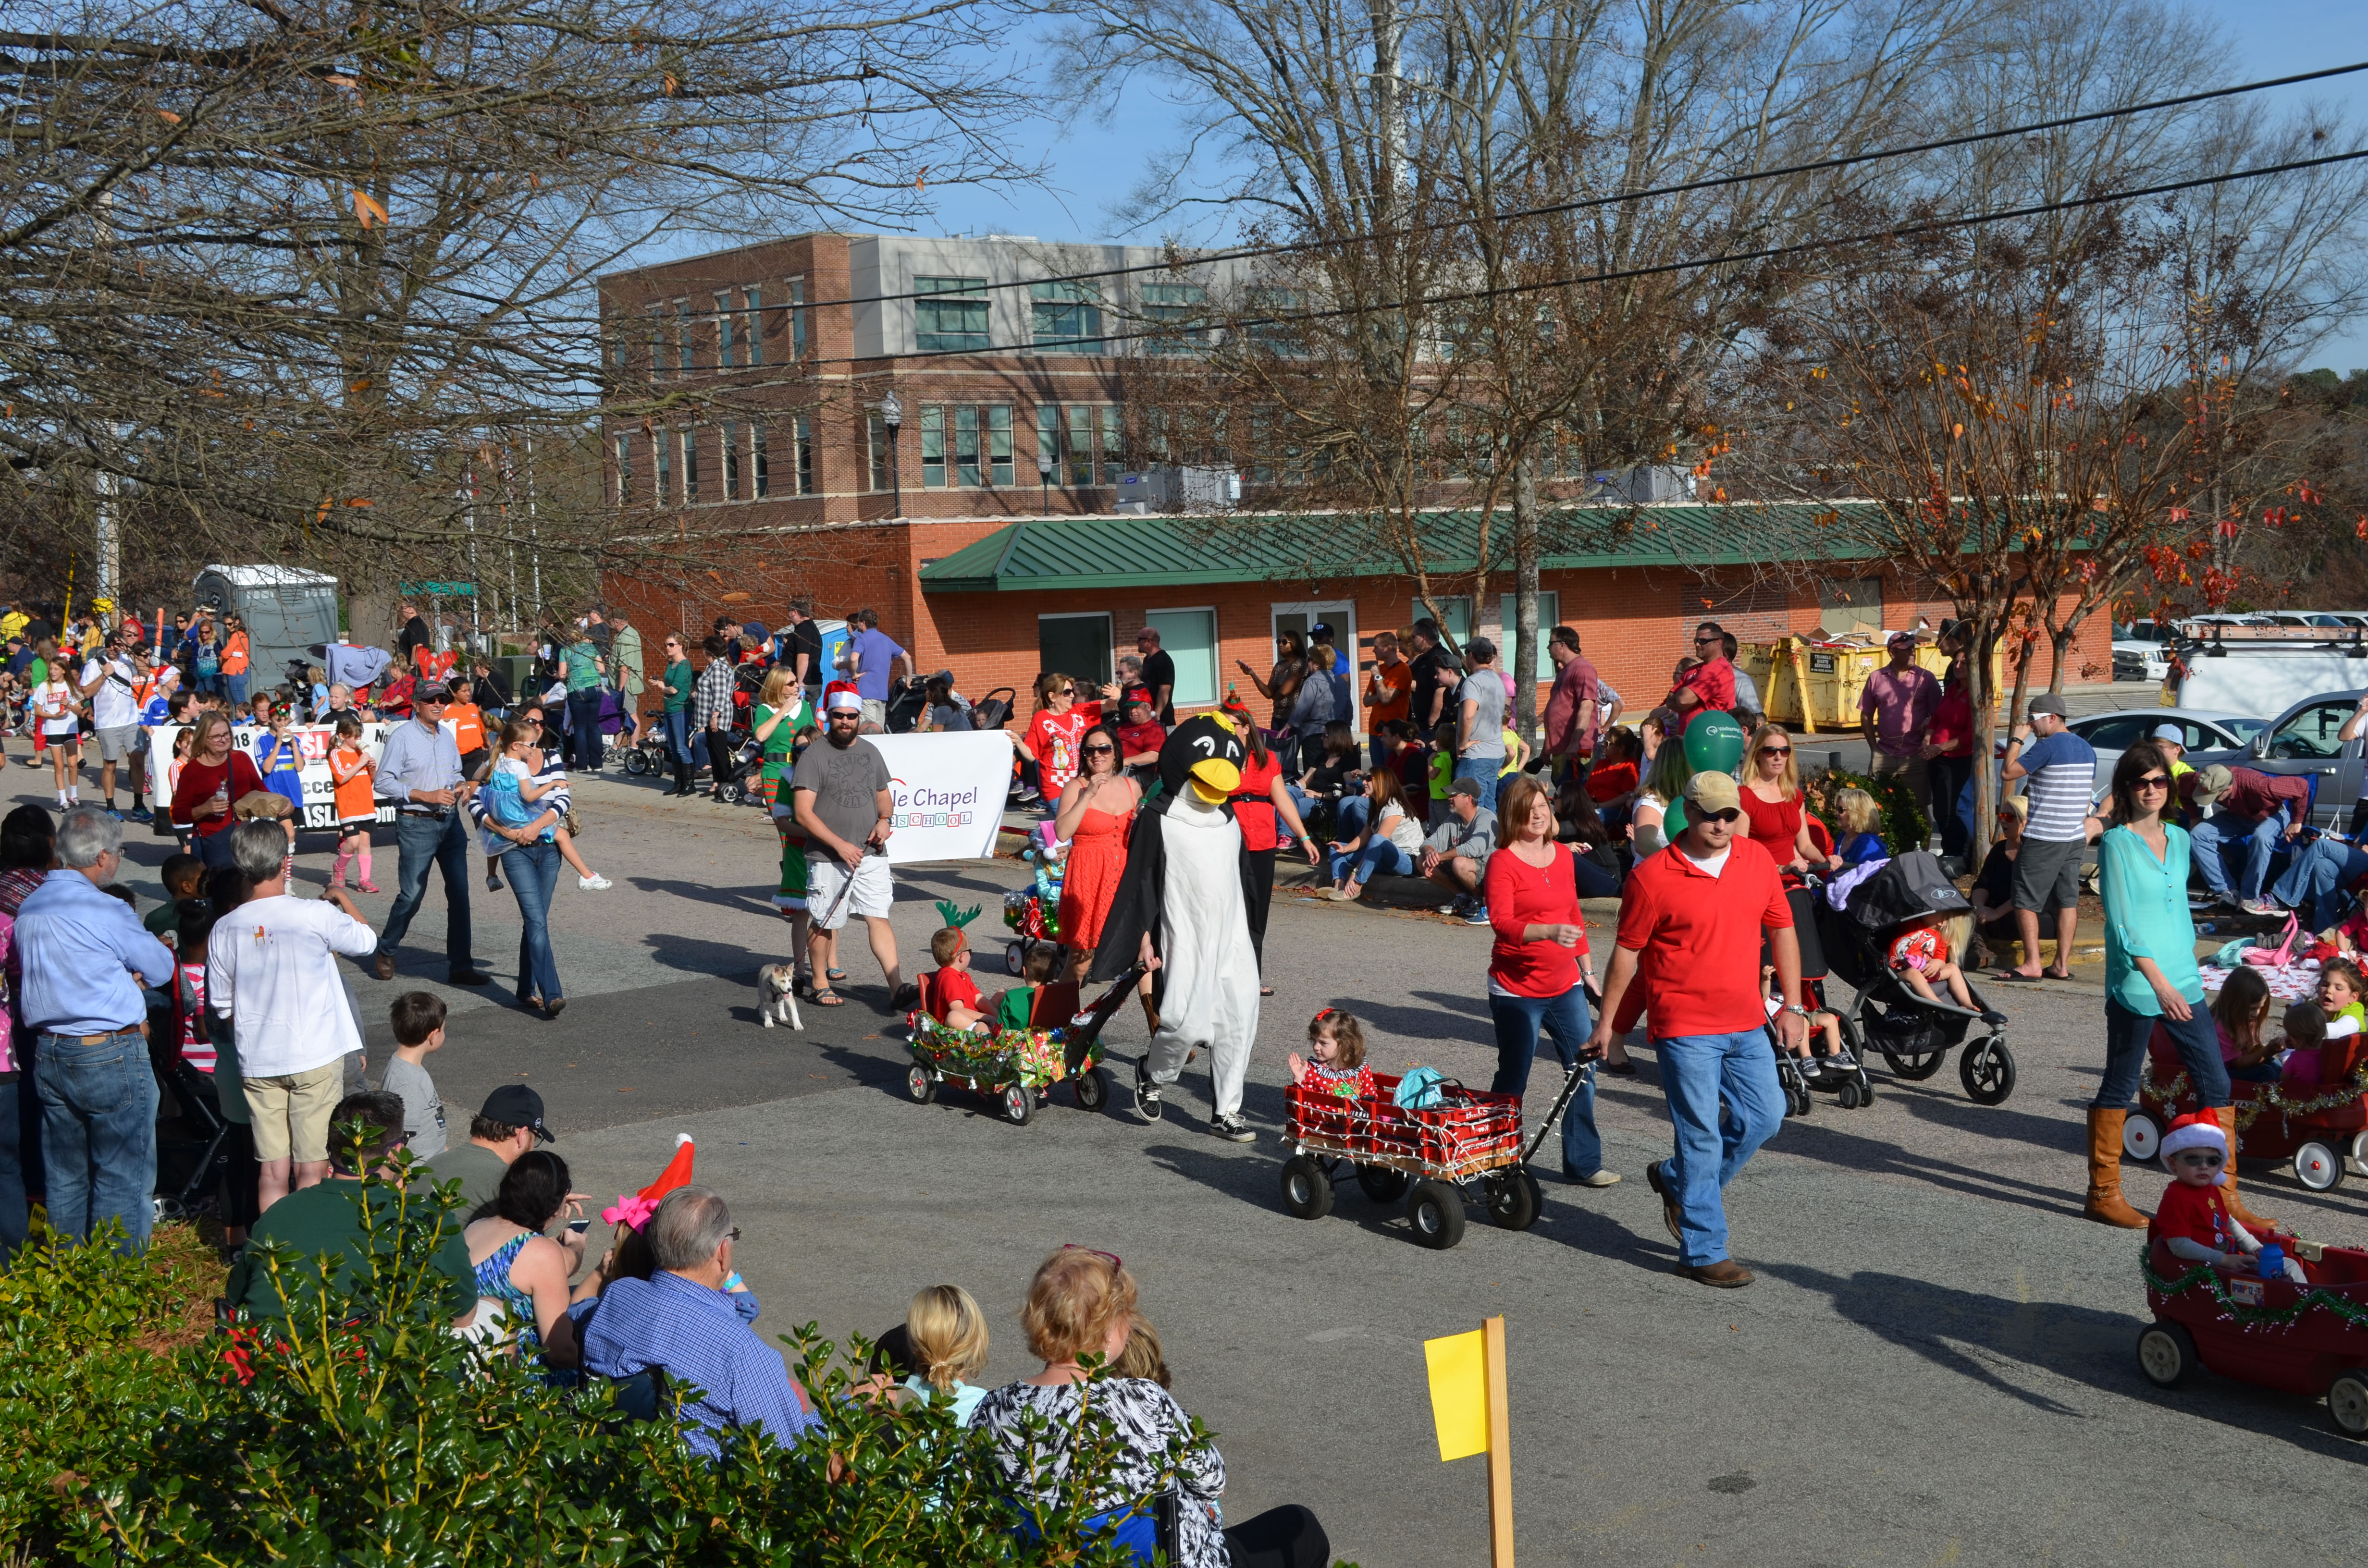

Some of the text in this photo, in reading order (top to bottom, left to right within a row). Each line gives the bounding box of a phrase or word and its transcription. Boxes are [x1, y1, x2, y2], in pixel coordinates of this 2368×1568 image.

[374, 729, 389, 744] No
[302, 735, 327, 756] SL
[301, 781, 334, 794] cce
[893, 786, 977, 811] le Chapel
[33, 1209, 46, 1223] NO
